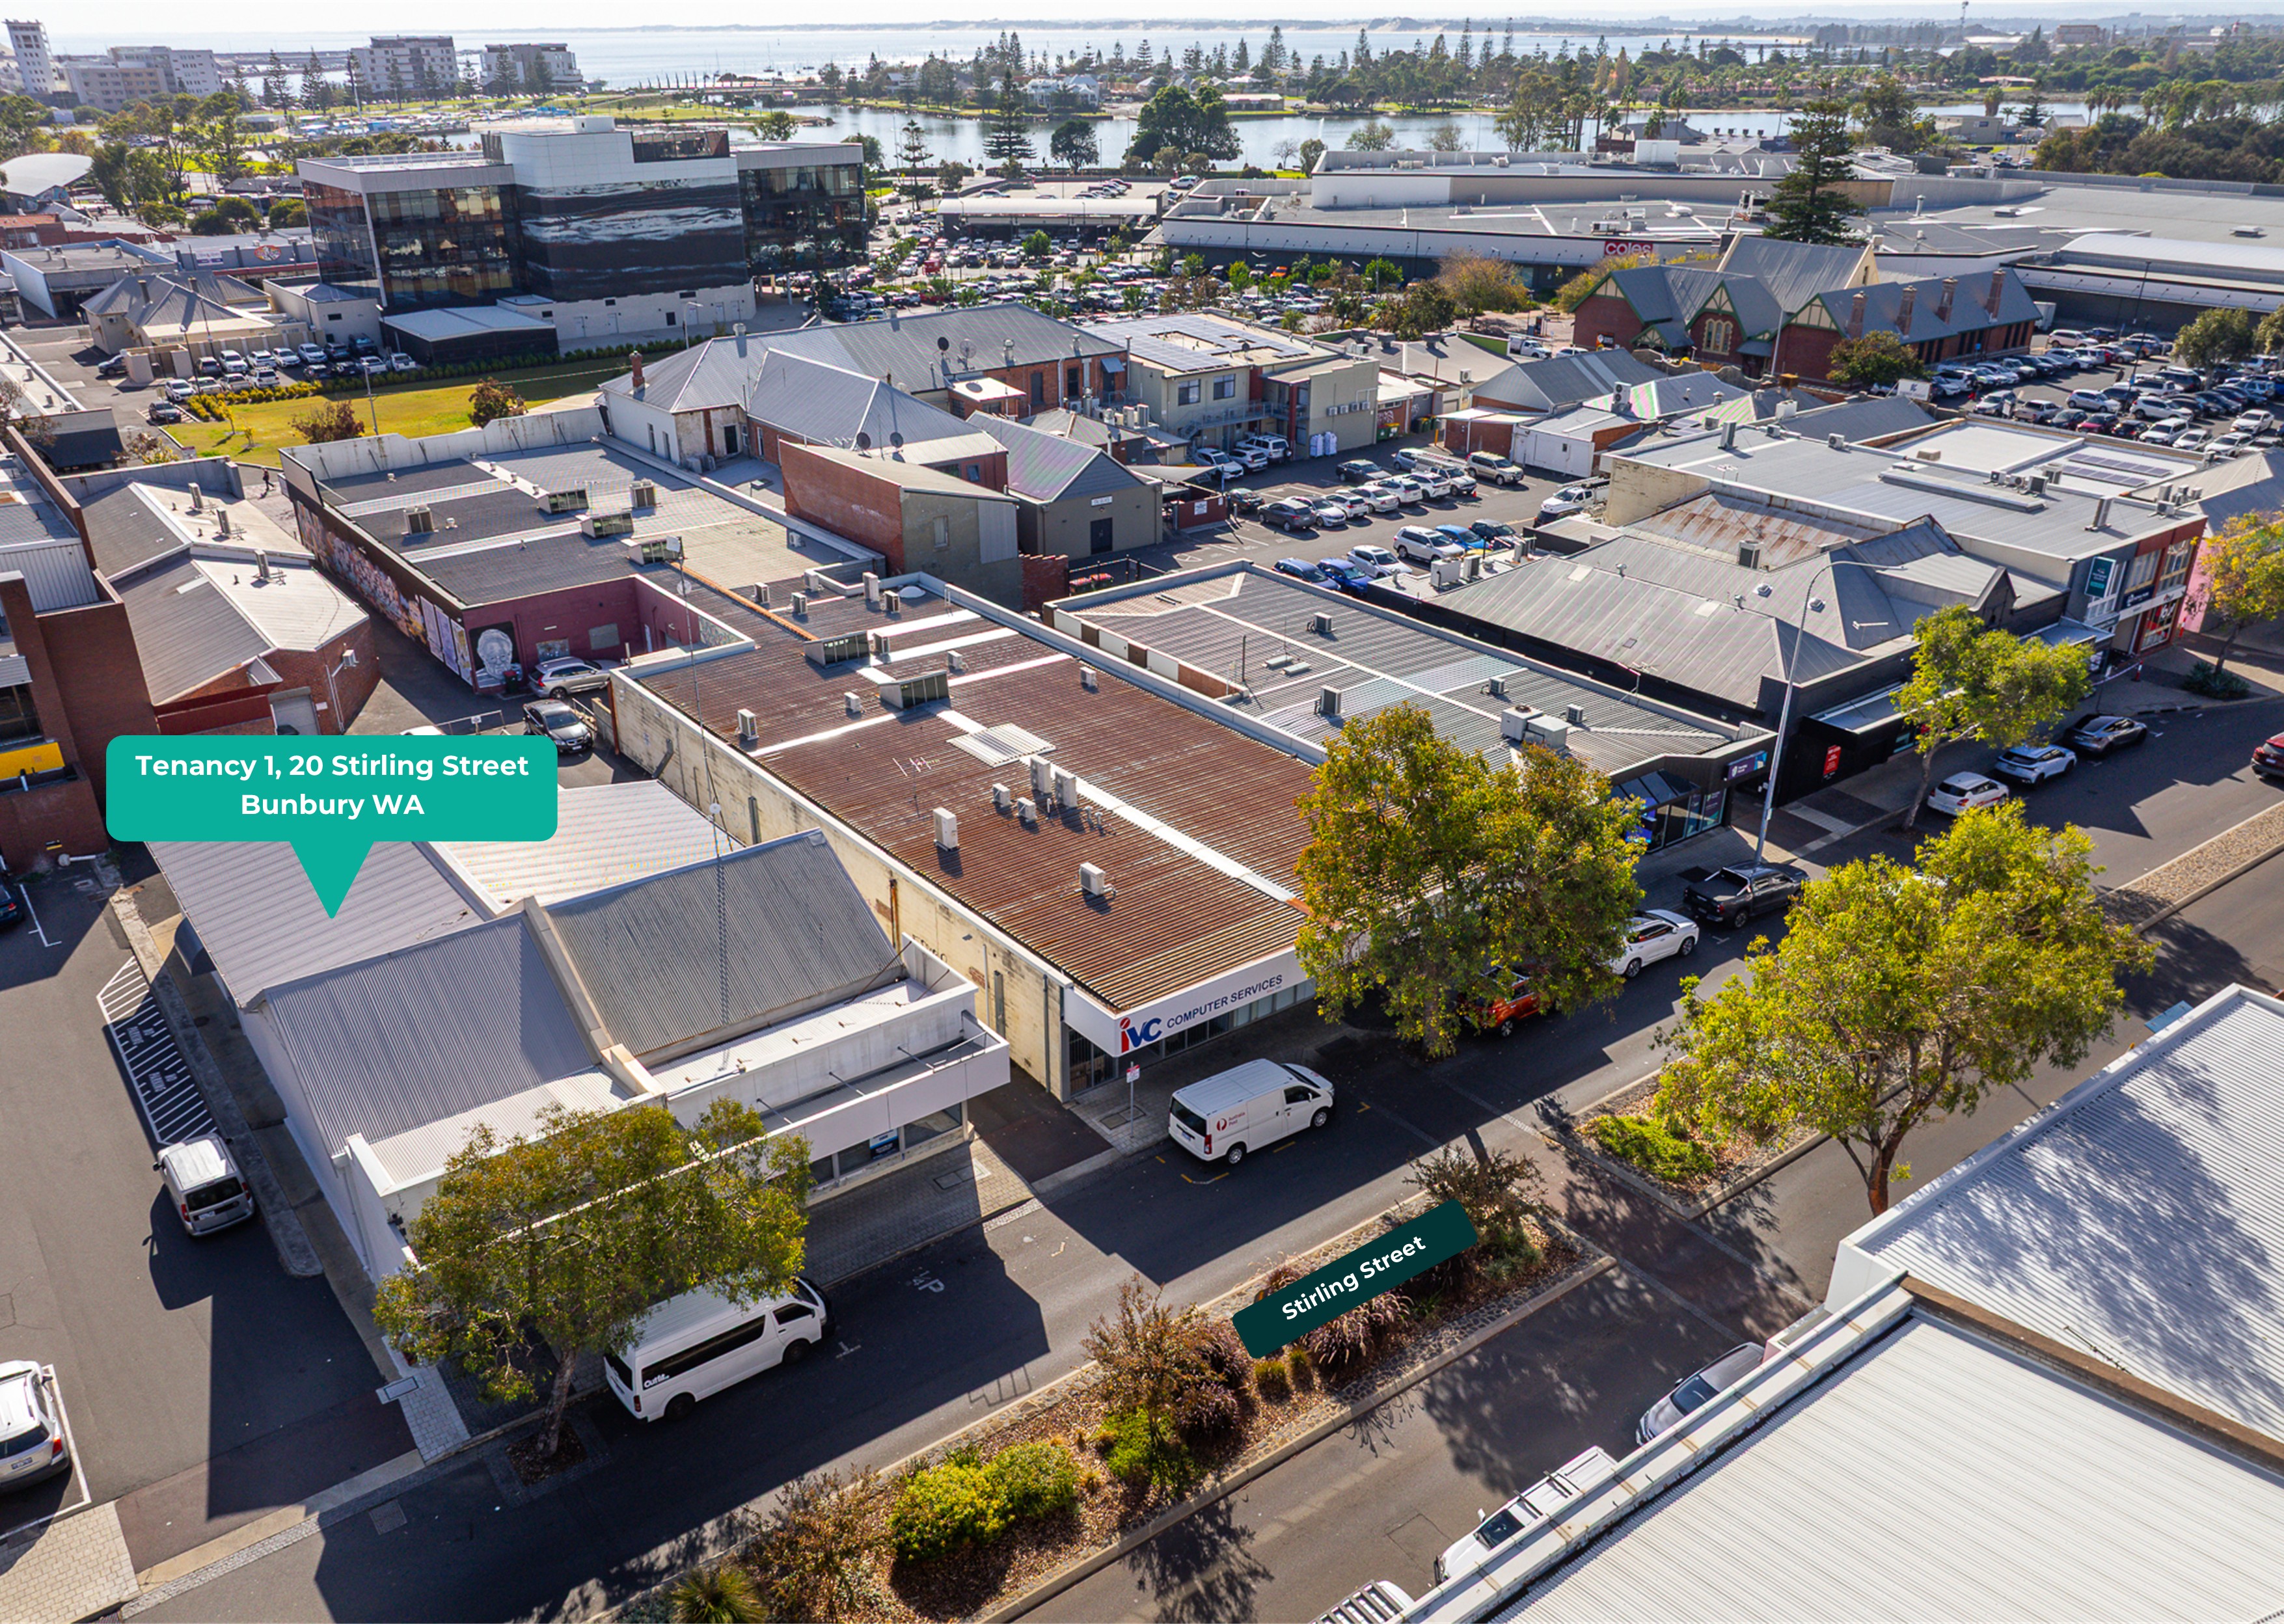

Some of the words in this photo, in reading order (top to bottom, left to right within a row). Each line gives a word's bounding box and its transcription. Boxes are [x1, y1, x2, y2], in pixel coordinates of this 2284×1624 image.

[1606, 242, 1651, 255] coles
[1167, 996, 1229, 1029] COMPUTER
[1230, 975, 1283, 1003] SERVICES
